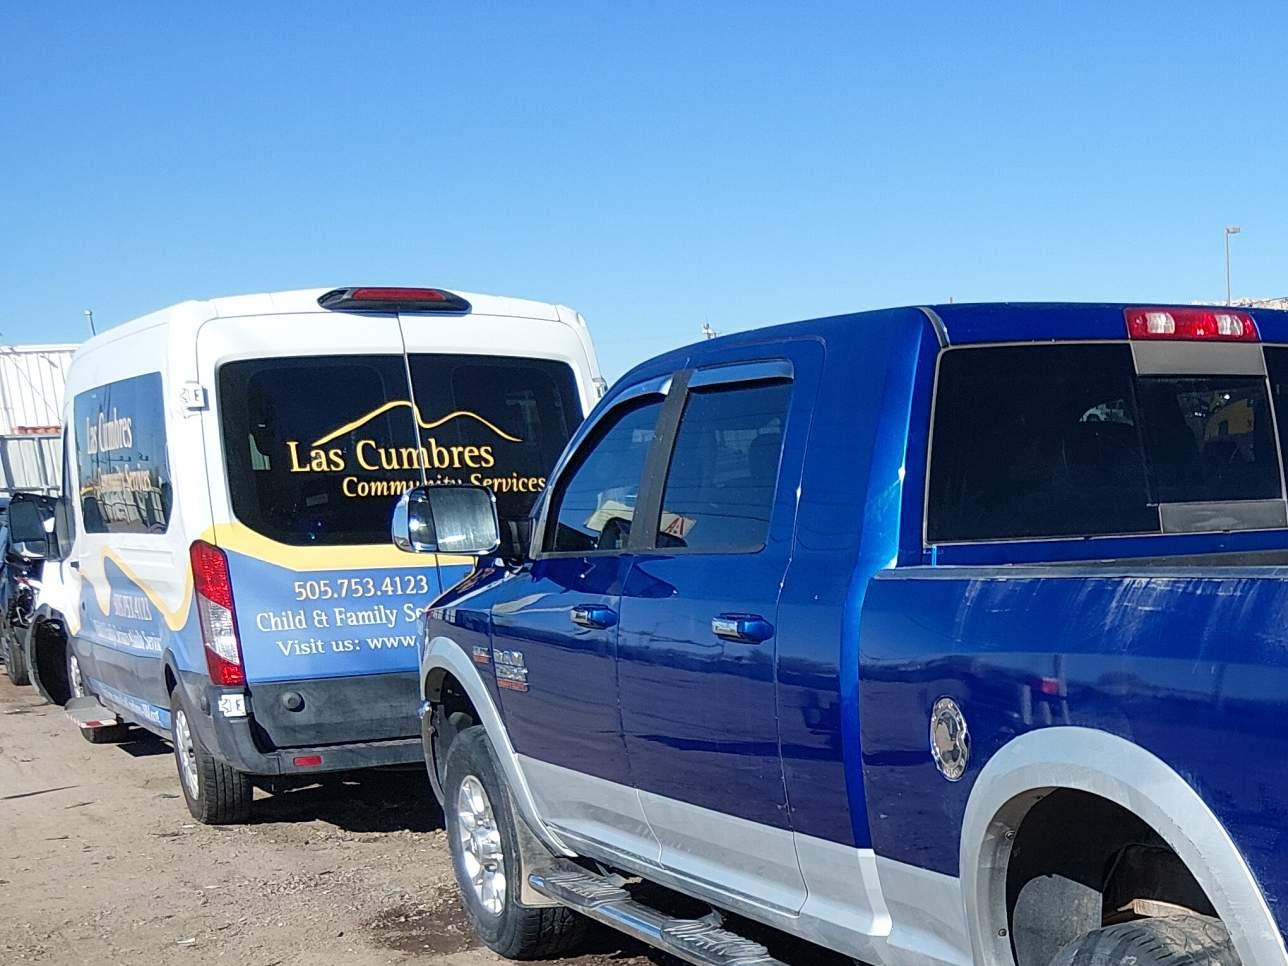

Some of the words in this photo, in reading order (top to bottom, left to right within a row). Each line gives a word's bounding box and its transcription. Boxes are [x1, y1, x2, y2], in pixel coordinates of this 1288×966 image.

[286, 441, 345, 472] Las
[356, 438, 495, 471] Cumbres
[294, 575, 429, 601] 505.753.4123
[256, 610, 307, 632] Child
[313, 610, 330, 628] &
[334, 604, 398, 627] Family
[276, 638, 325, 657] Visit
[332, 638, 360, 652] us:
